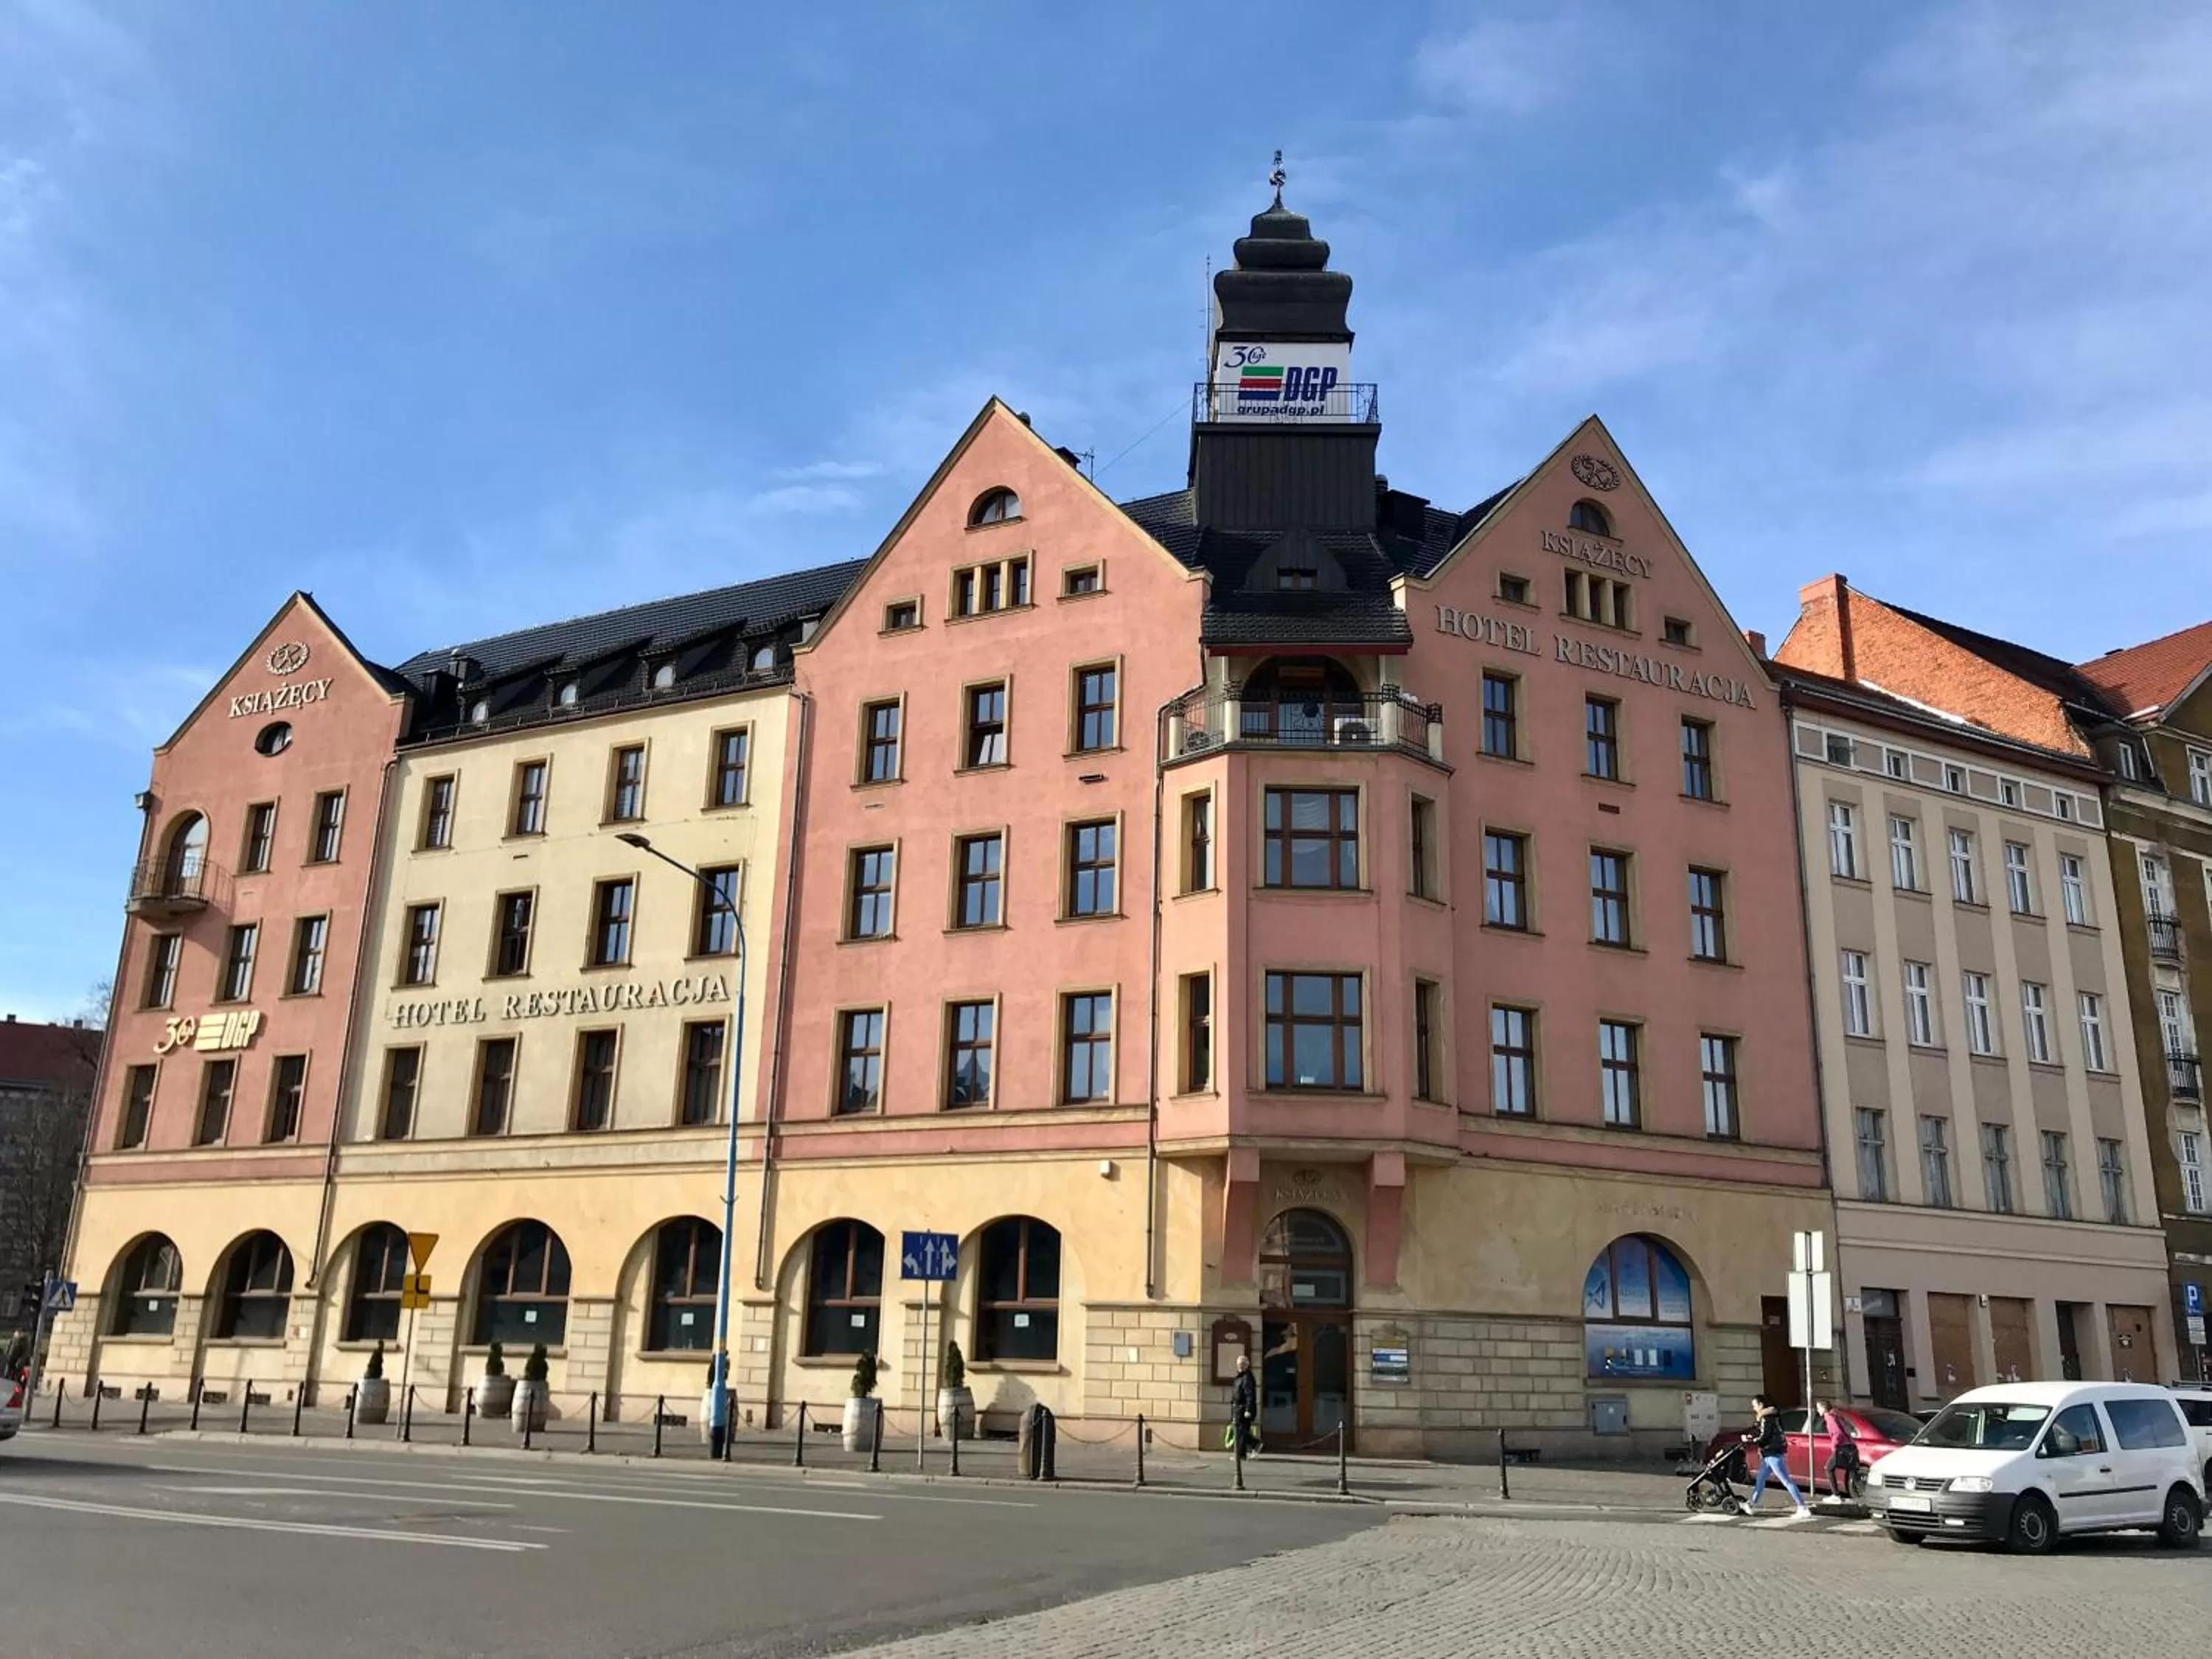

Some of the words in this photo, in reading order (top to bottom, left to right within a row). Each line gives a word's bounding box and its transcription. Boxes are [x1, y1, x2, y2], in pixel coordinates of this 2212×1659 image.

[1224, 346, 1265, 368] 30
[1284, 366, 1338, 401] DGP
[1237, 406, 1325, 416] grupadgp.pl
[1541, 530, 1652, 578] KSIĄŻĘCY
[1435, 605, 1543, 656] HOTEL
[1554, 634, 1757, 710] RESTAURACJA
[228, 678, 333, 718] KSIĄŻĘCY
[392, 997, 486, 1029] HOTEL
[501, 975, 731, 1020] RESTAURACJA
[221, 1010, 260, 1048] DGP
[2187, 1285, 2198, 1306] P
